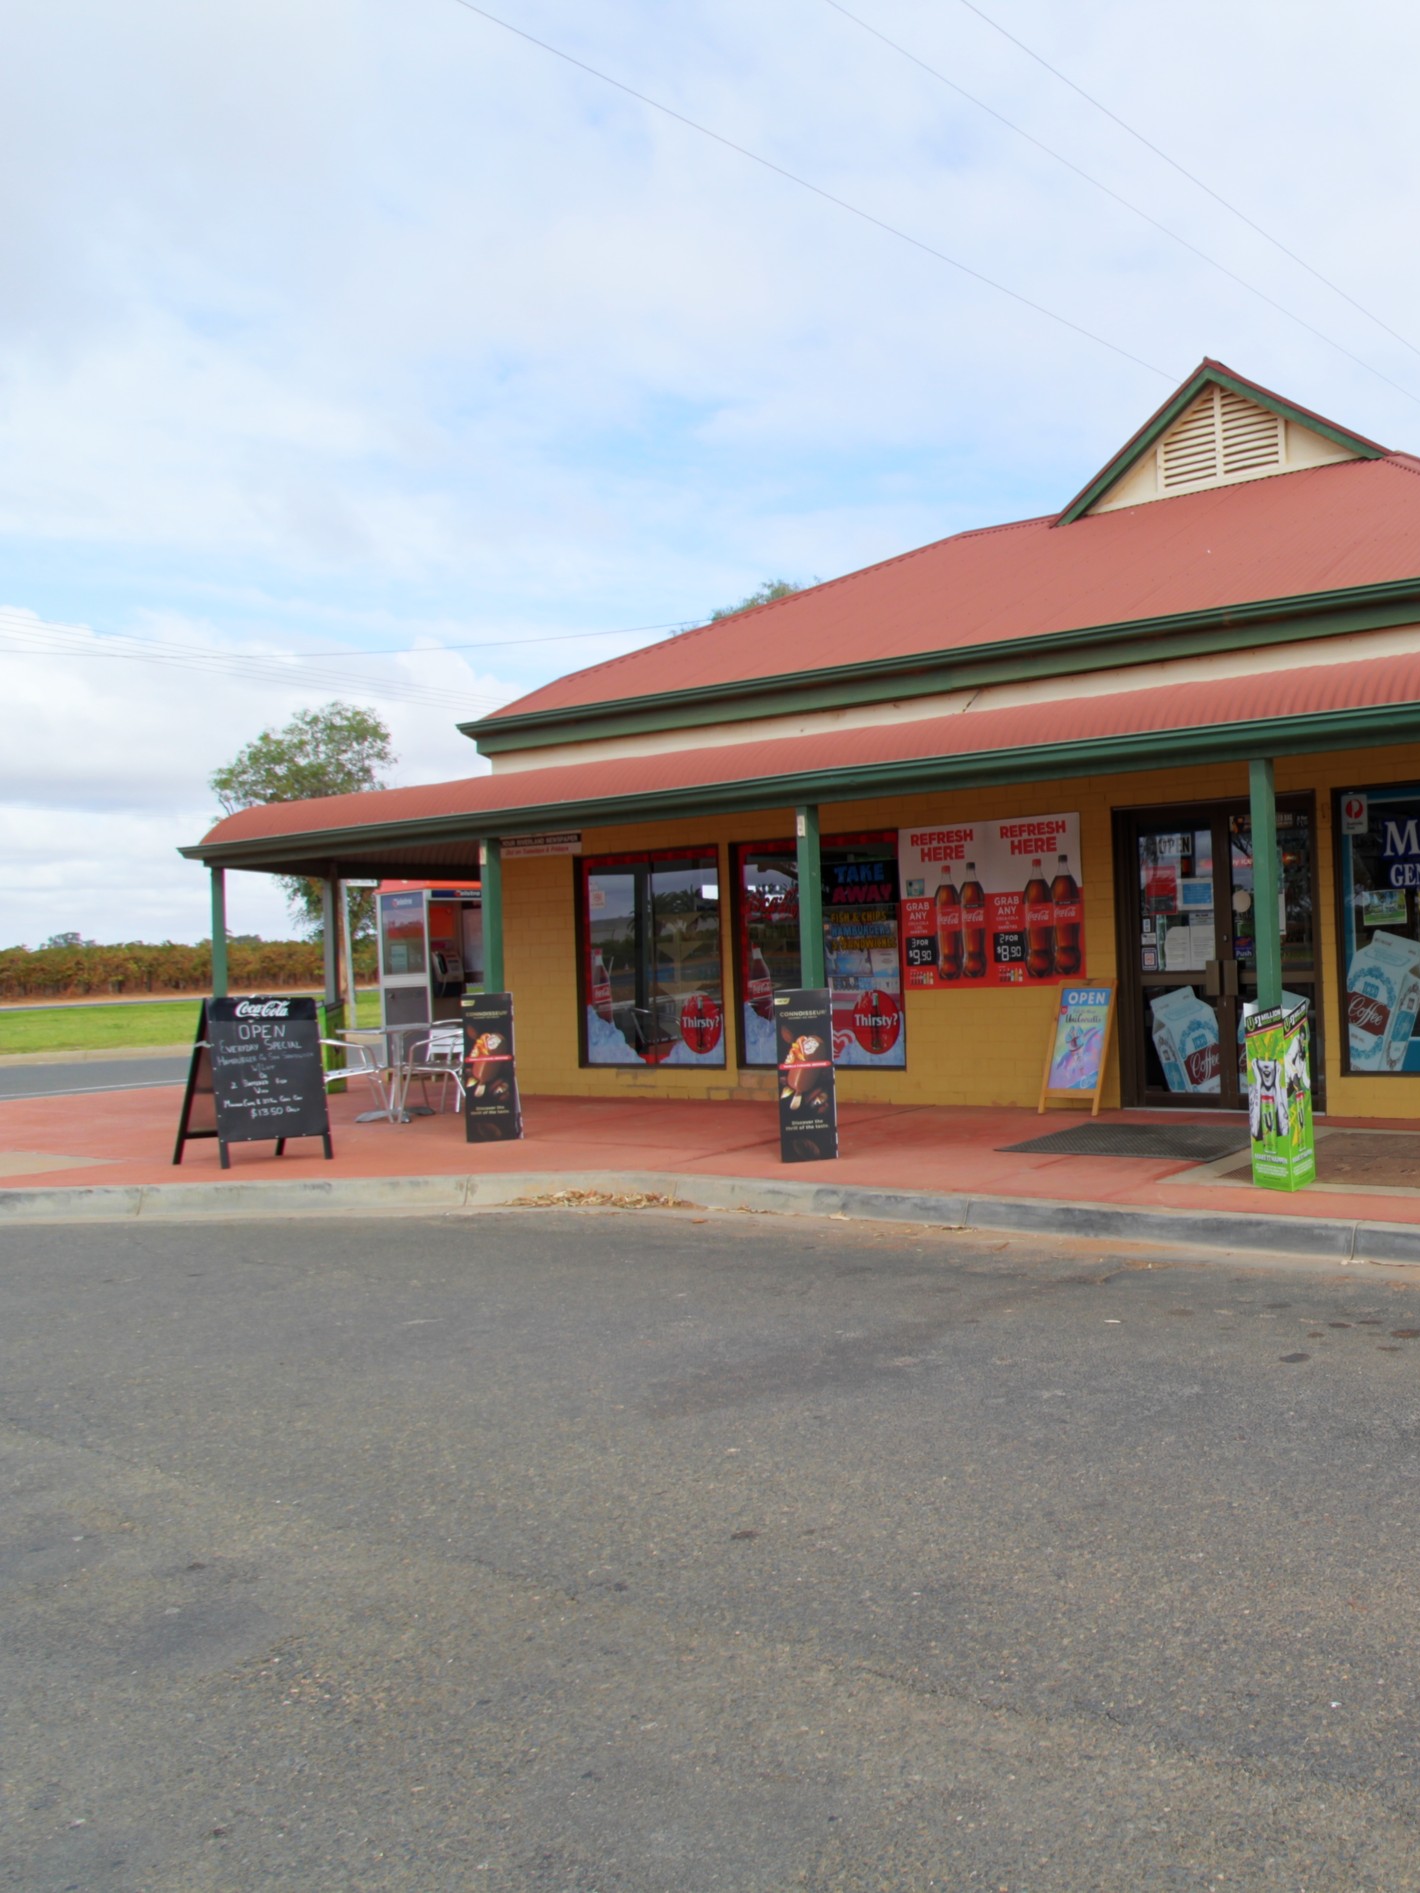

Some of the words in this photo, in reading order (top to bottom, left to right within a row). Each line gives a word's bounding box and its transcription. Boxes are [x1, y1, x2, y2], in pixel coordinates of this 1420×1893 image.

[1000, 820, 1066, 839] REFRESH
[546, 834, 579, 843] NEWSPAPER
[911, 829, 974, 847] REFRESH
[1010, 836, 1058, 855] HERE
[921, 844, 966, 863] HERE
[834, 863, 885, 885] TAKE
[832, 883, 893, 904] AWAY
[994, 896, 1020, 906] GRAB
[906, 902, 930, 911] GRAB
[997, 906, 1017, 916] ANY
[831, 912, 851, 923] FISH
[862, 910, 887, 921] CHIPS
[909, 911, 927, 921] ANY
[831, 923, 893, 938] HAMBURGERS
[911, 938, 917, 948] 3
[917, 939, 929, 947] FOR
[999, 933, 1005, 944] 2
[1005, 934, 1019, 943] FOR
[1236, 949, 1253, 957] Push
[1068, 991, 1106, 1005] OPEN
[234, 1001, 291, 1019] Coca-Cola
[779, 1009, 826, 1018] CONNOISSEUR
[1348, 995, 1384, 1027] Coffee
[682, 1015, 721, 1030] Thirsty?
[854, 1012, 898, 1030] Thirsty?
[239, 1025, 286, 1040] OPEN
[219, 1040, 259, 1054] EVERYDAY
[263, 1039, 303, 1052] SPECIAL
